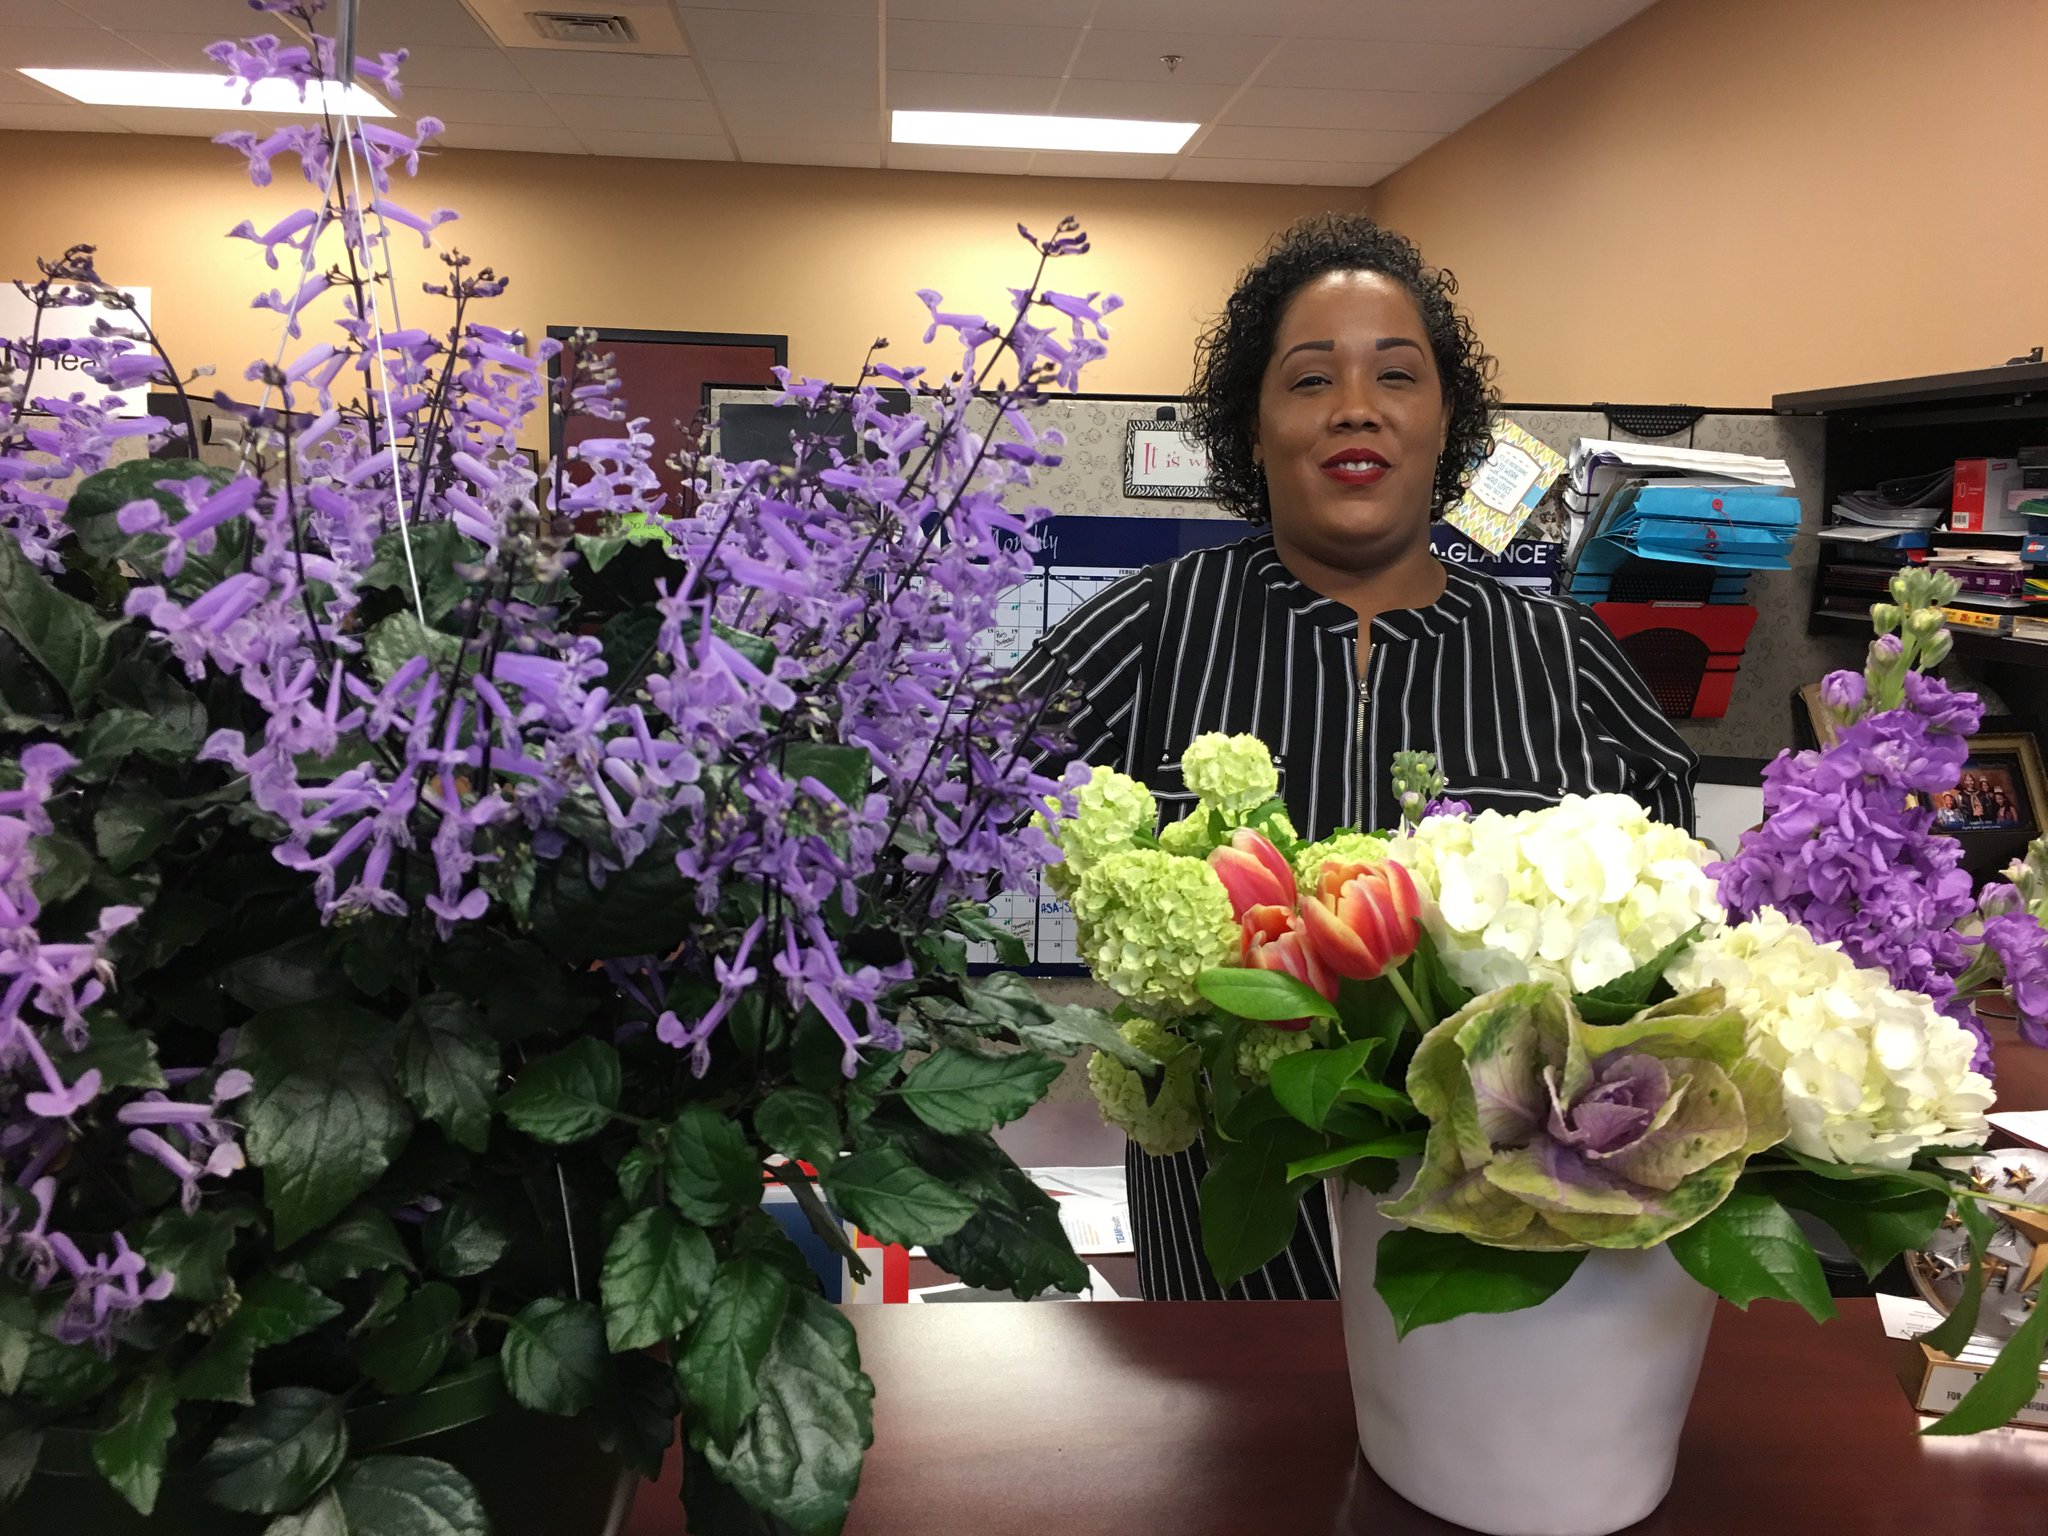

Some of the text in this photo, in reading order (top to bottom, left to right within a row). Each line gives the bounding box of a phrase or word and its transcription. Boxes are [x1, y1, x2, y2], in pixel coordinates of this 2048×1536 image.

[1143, 442, 1158, 475] It
[1166, 450, 1180, 468] is
[1504, 467, 1519, 480] WORK
[1486, 474, 1513, 495] WHO LOVES
[1946, 1391, 1962, 1400] FOR
